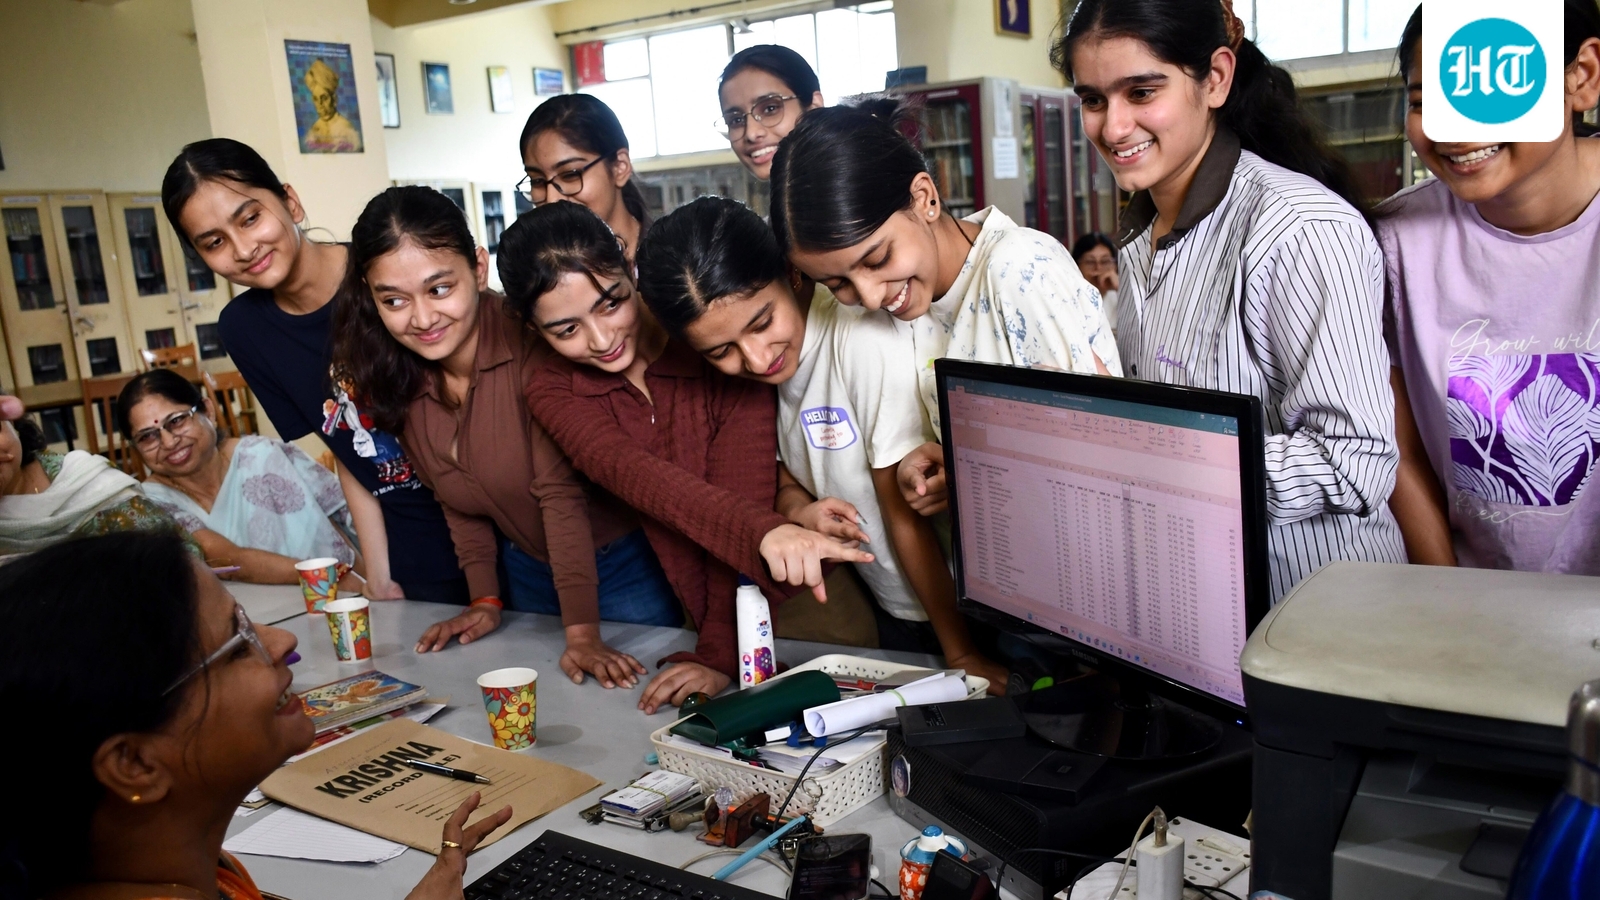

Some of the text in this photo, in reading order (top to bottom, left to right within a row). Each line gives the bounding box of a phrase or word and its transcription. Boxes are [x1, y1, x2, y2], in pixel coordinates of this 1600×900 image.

[1447, 318, 1541, 369] Grow
[315, 741, 446, 799] KRISHNA
[358, 772, 424, 804] (RECORD
